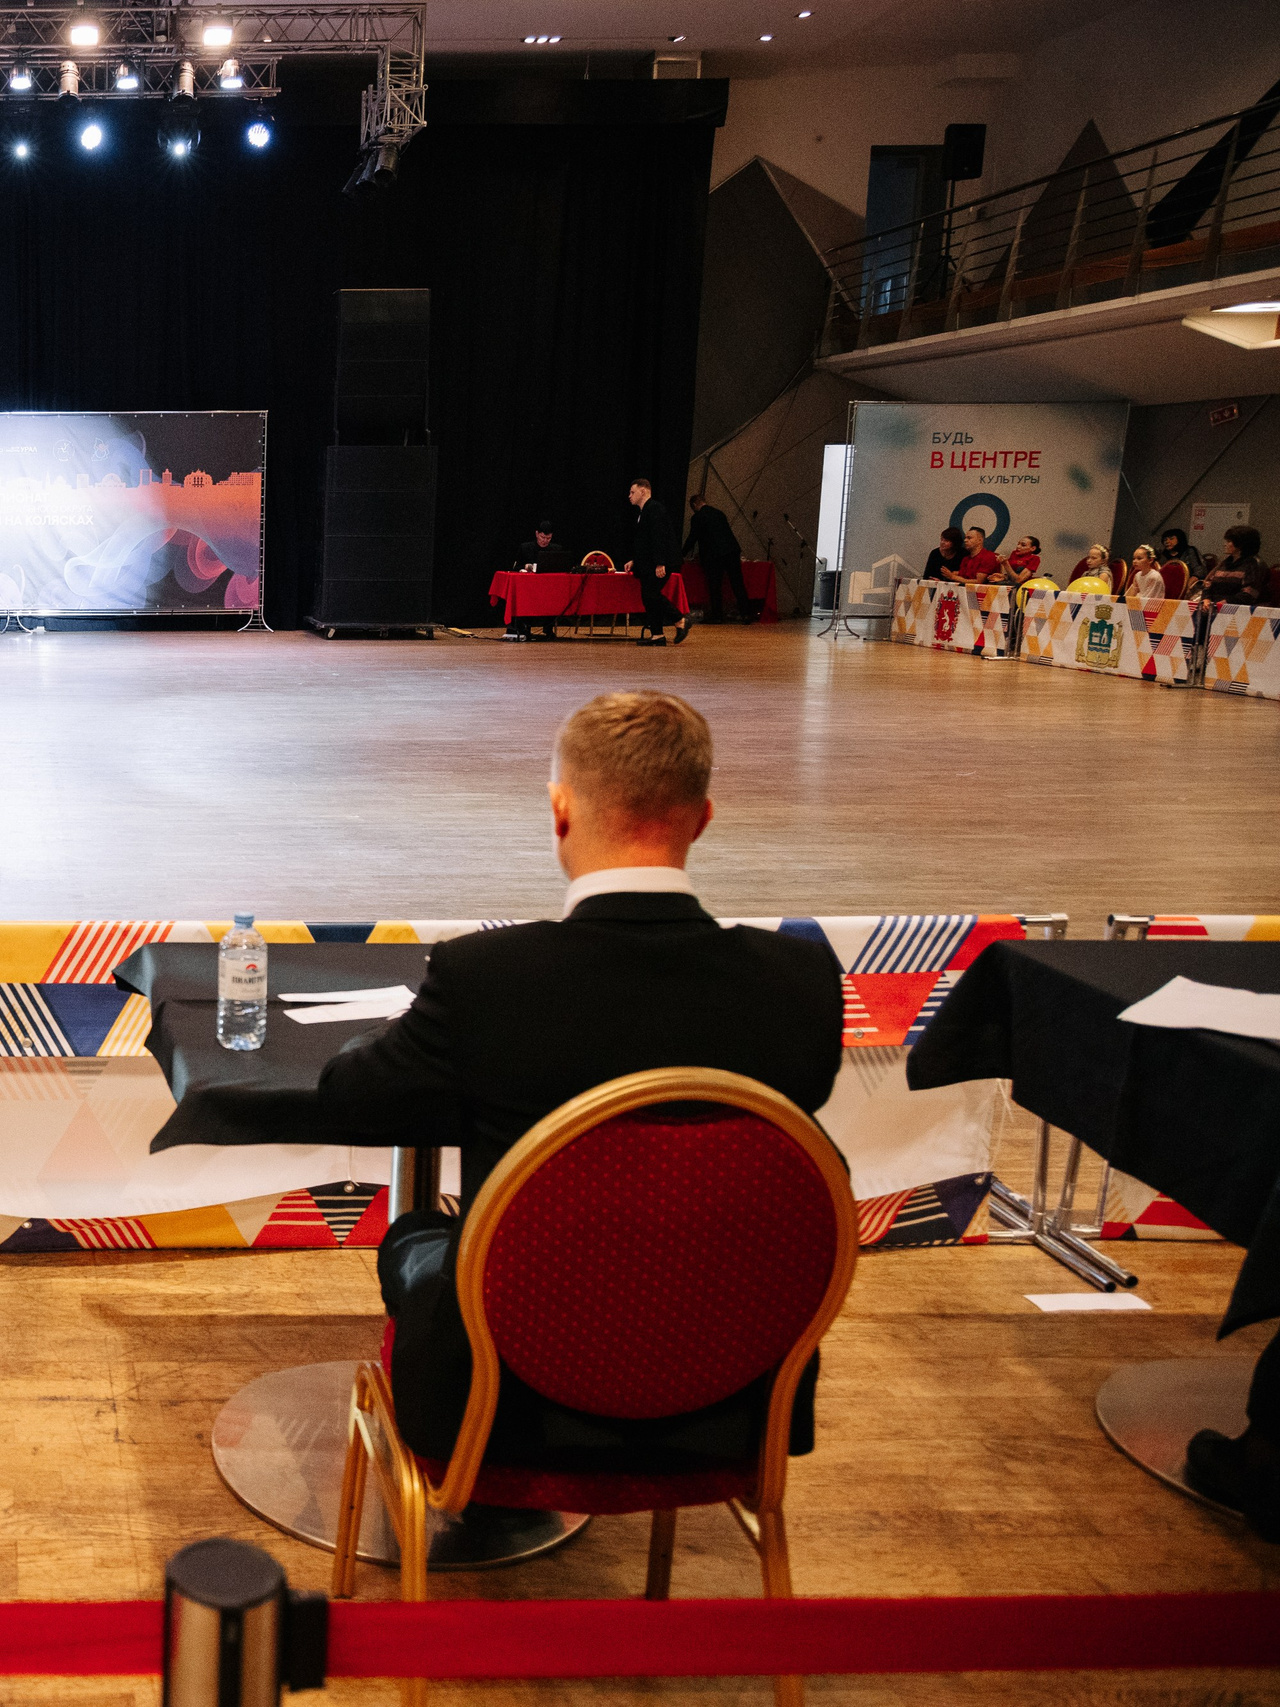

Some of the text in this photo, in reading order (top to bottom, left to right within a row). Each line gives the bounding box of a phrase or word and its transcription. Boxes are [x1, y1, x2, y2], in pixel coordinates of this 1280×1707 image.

[932, 432, 974, 445] БУДЬ
[930, 451, 1042, 471] В ЦЕНТРЕ
[979, 475, 1040, 484] КУЛЬТУРЫ
[5, 516, 22, 526] НА
[26, 515, 94, 526] КОЛЯСКАХ
